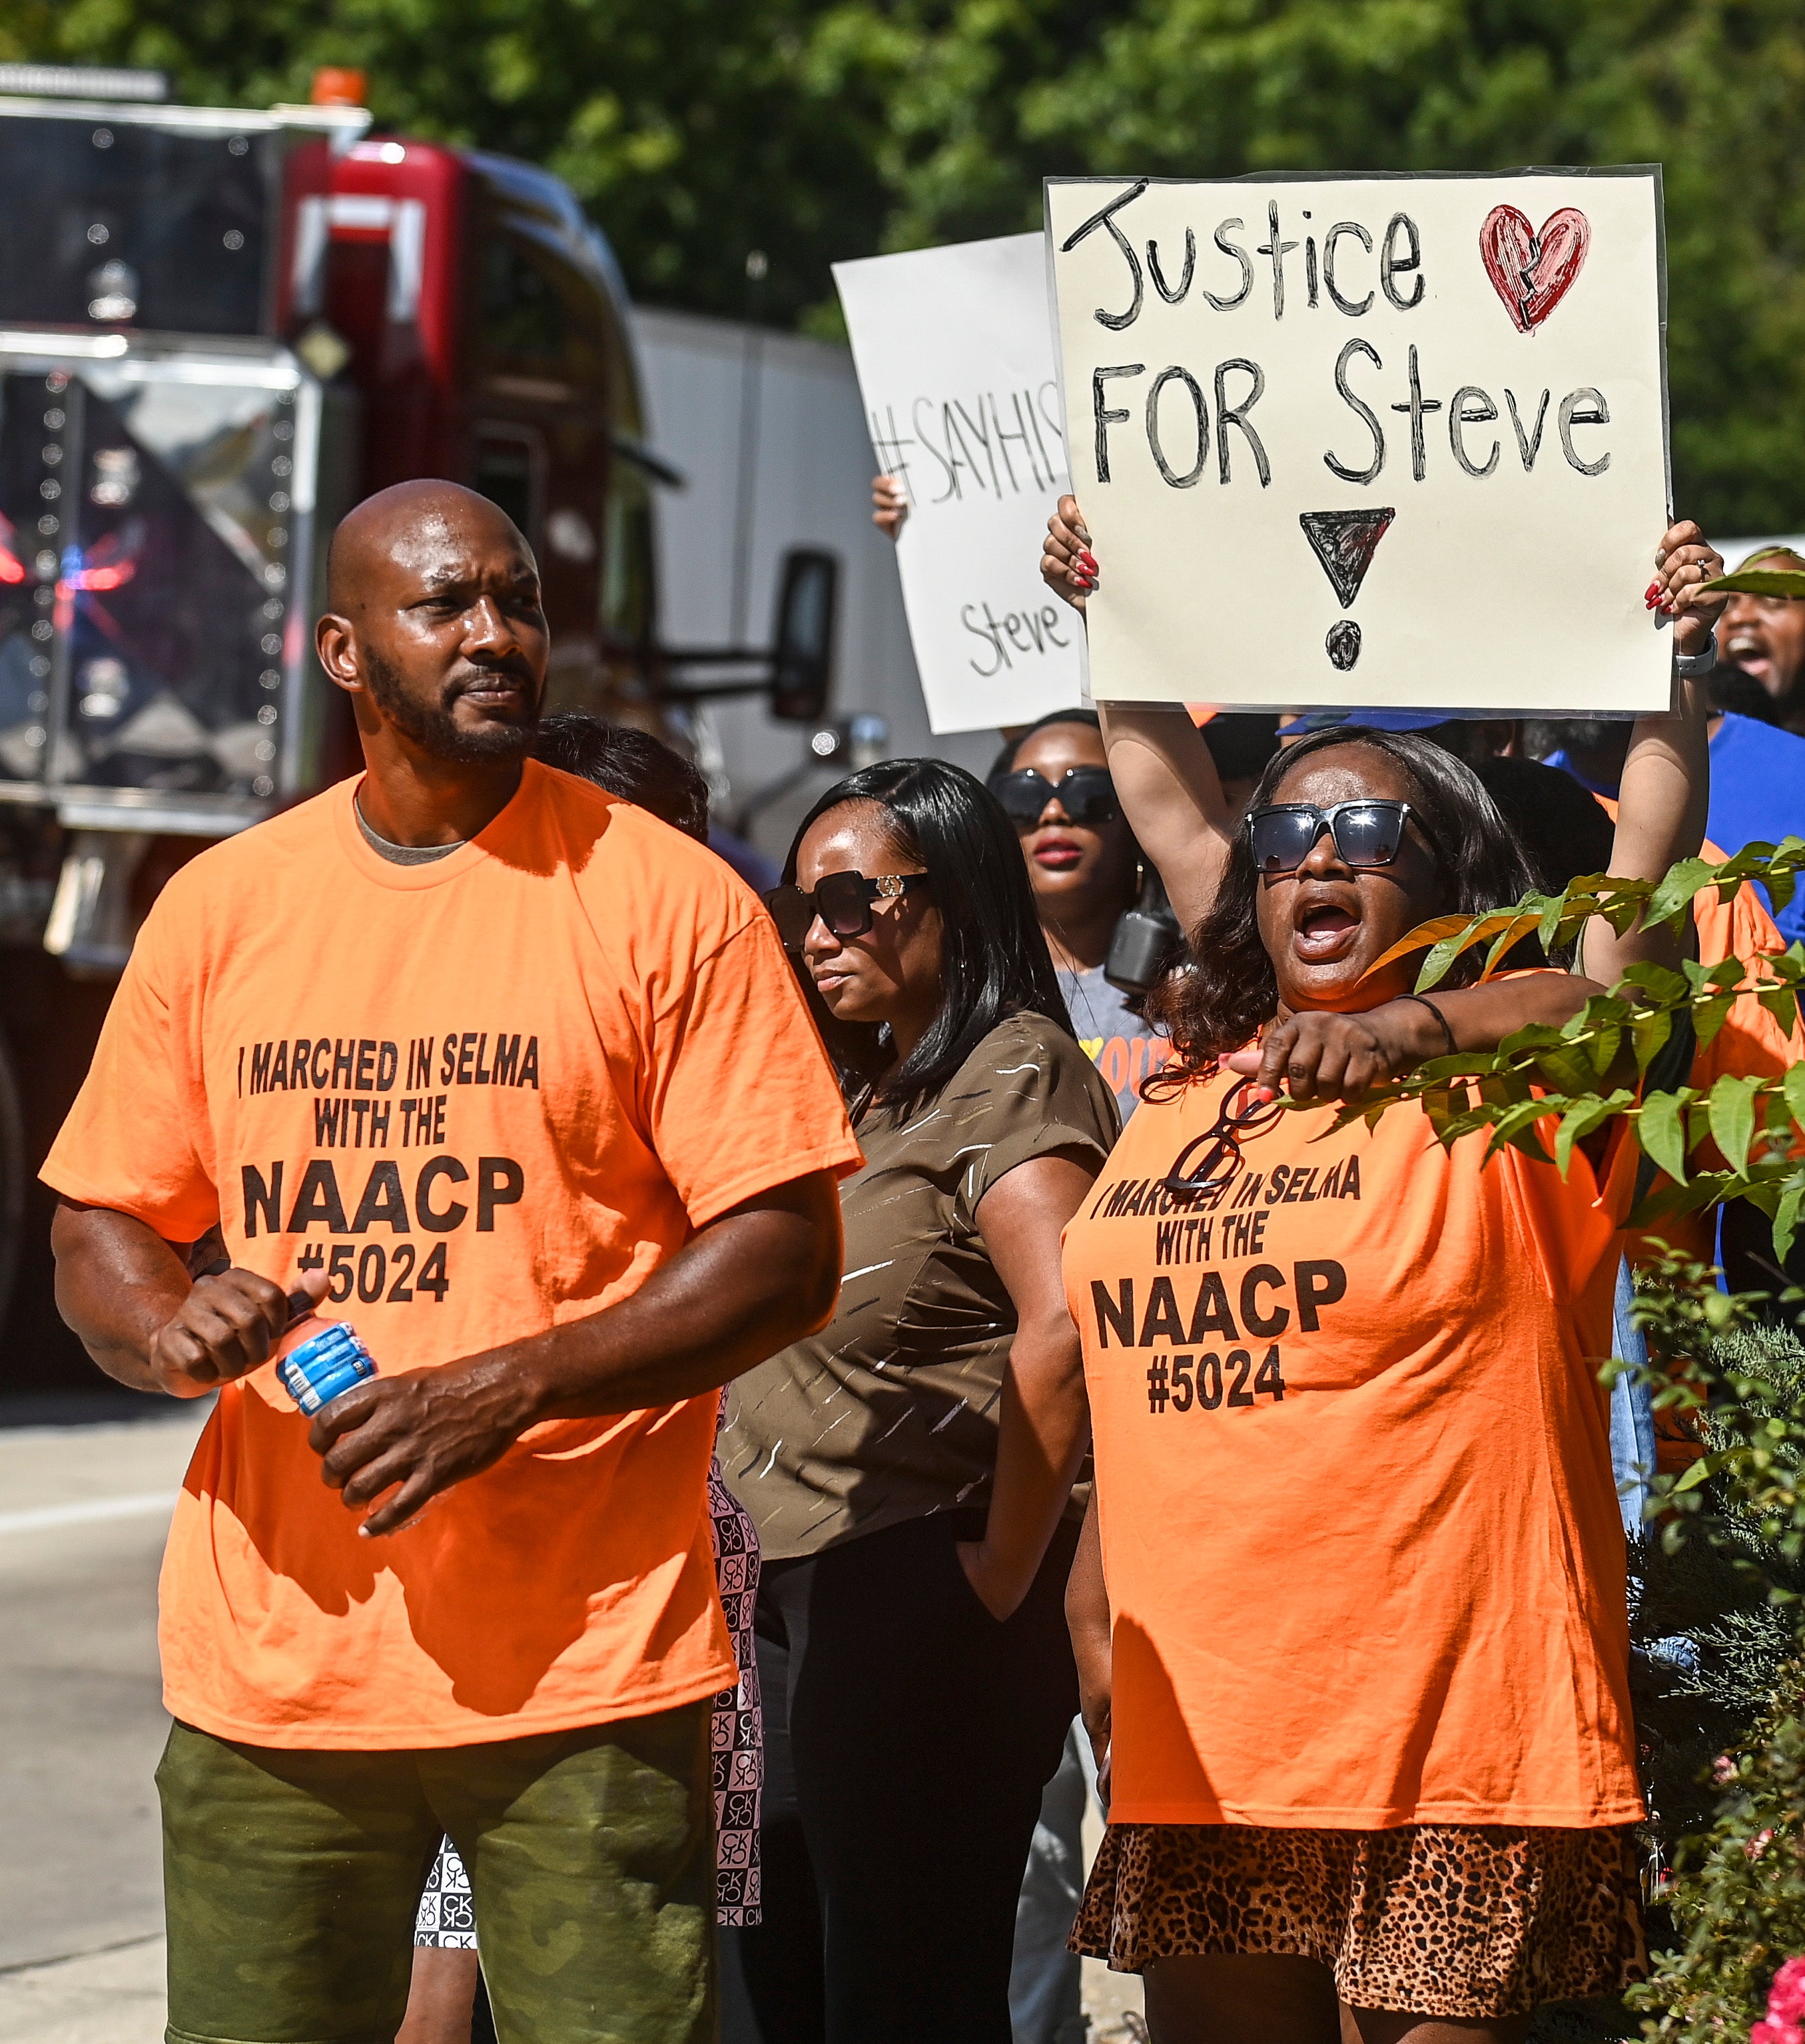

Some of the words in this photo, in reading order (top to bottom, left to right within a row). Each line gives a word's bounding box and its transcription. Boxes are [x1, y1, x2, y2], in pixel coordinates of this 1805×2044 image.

[1059, 176, 1425, 331] Justice
[1093, 357, 1270, 489] FOR
[1323, 338, 1611, 485] Steve
[960, 601, 1070, 677] Steve
[238, 1046, 245, 1099] I
[250, 1038, 398, 1096] MARCHED
[406, 1036, 434, 1091] IN
[440, 1032, 540, 1090] SELMA
[314, 1098, 391, 1148] WITH
[400, 1094, 447, 1148] THE
[241, 1155, 525, 1239] NAACP
[1089, 1183, 1115, 1220] I
[1230, 1172, 1267, 1209] IN
[1265, 1154, 1361, 1204] SELMA
[1156, 1216, 1214, 1265] WITH
[1222, 1210, 1270, 1259] THE
[1090, 1259, 1347, 1349] NAACP
[1146, 1344, 1287, 1413] #5024
[720, 1518, 740, 1536] CK
[724, 1557, 744, 1574] CK
[729, 1794, 753, 1810] CK
[723, 1833, 749, 1849] CK
[444, 1895, 472, 1913] CK
